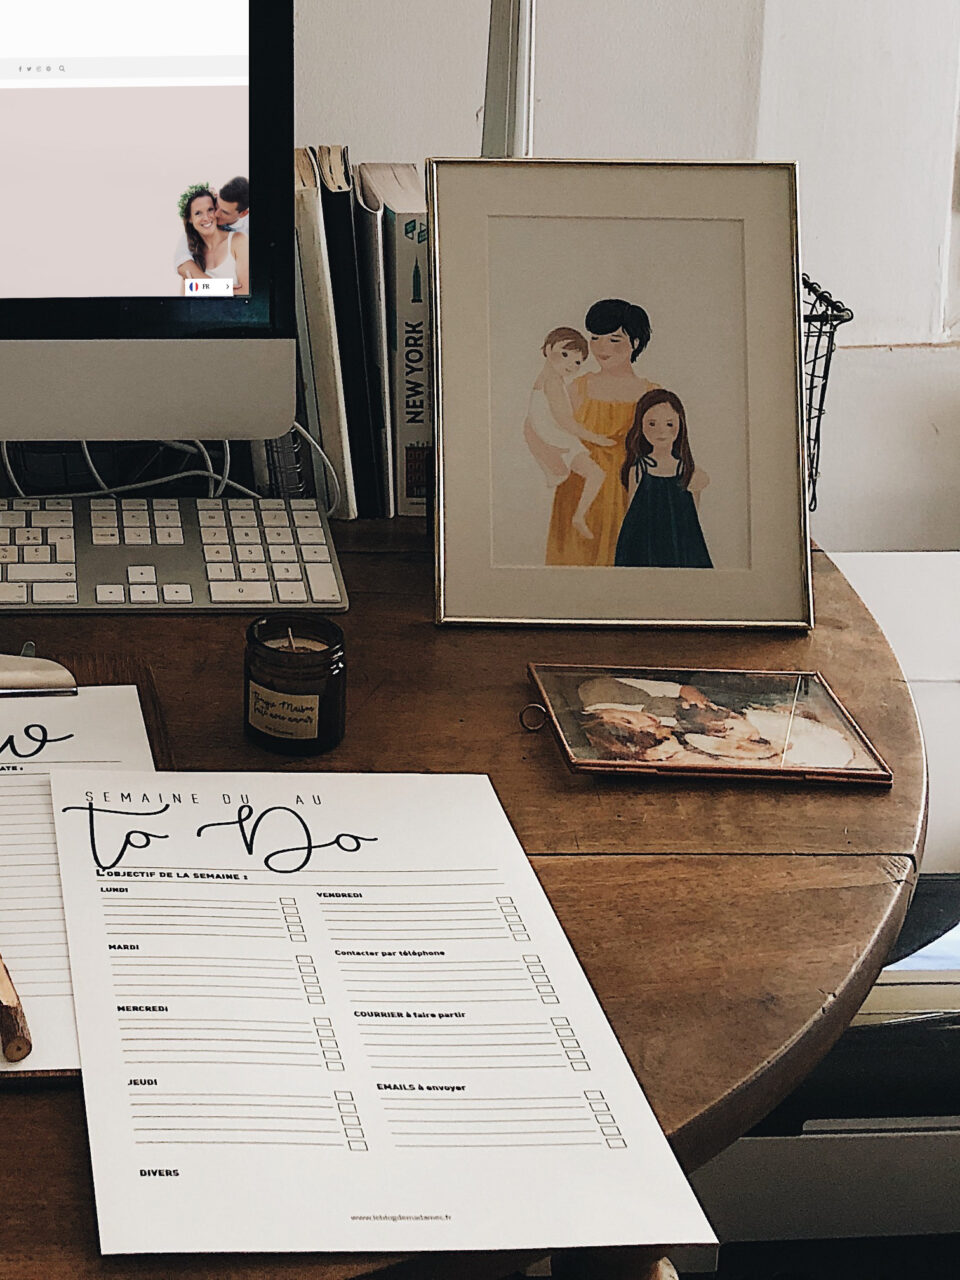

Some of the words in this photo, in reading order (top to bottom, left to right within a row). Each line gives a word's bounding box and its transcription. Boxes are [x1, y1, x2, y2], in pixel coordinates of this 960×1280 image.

[404, 321, 424, 377] YORK
[405, 379, 425, 424] NEW
[84, 791, 201, 806] SEMAINE
[222, 793, 251, 807] DU
[295, 794, 322, 807] AU
[196, 804, 378, 874] Do
[334, 949, 379, 957] Contacter
[398, 949, 445, 957] téléphone
[353, 1010, 404, 1018] COURRIER
[412, 1011, 437, 1019] faire
[437, 1011, 466, 1019] partir
[127, 1078, 158, 1086] JEUDI
[376, 1083, 416, 1091] EMAILS
[426, 1084, 466, 1093] envoyer
[139, 1168, 180, 1177] DIVERS
